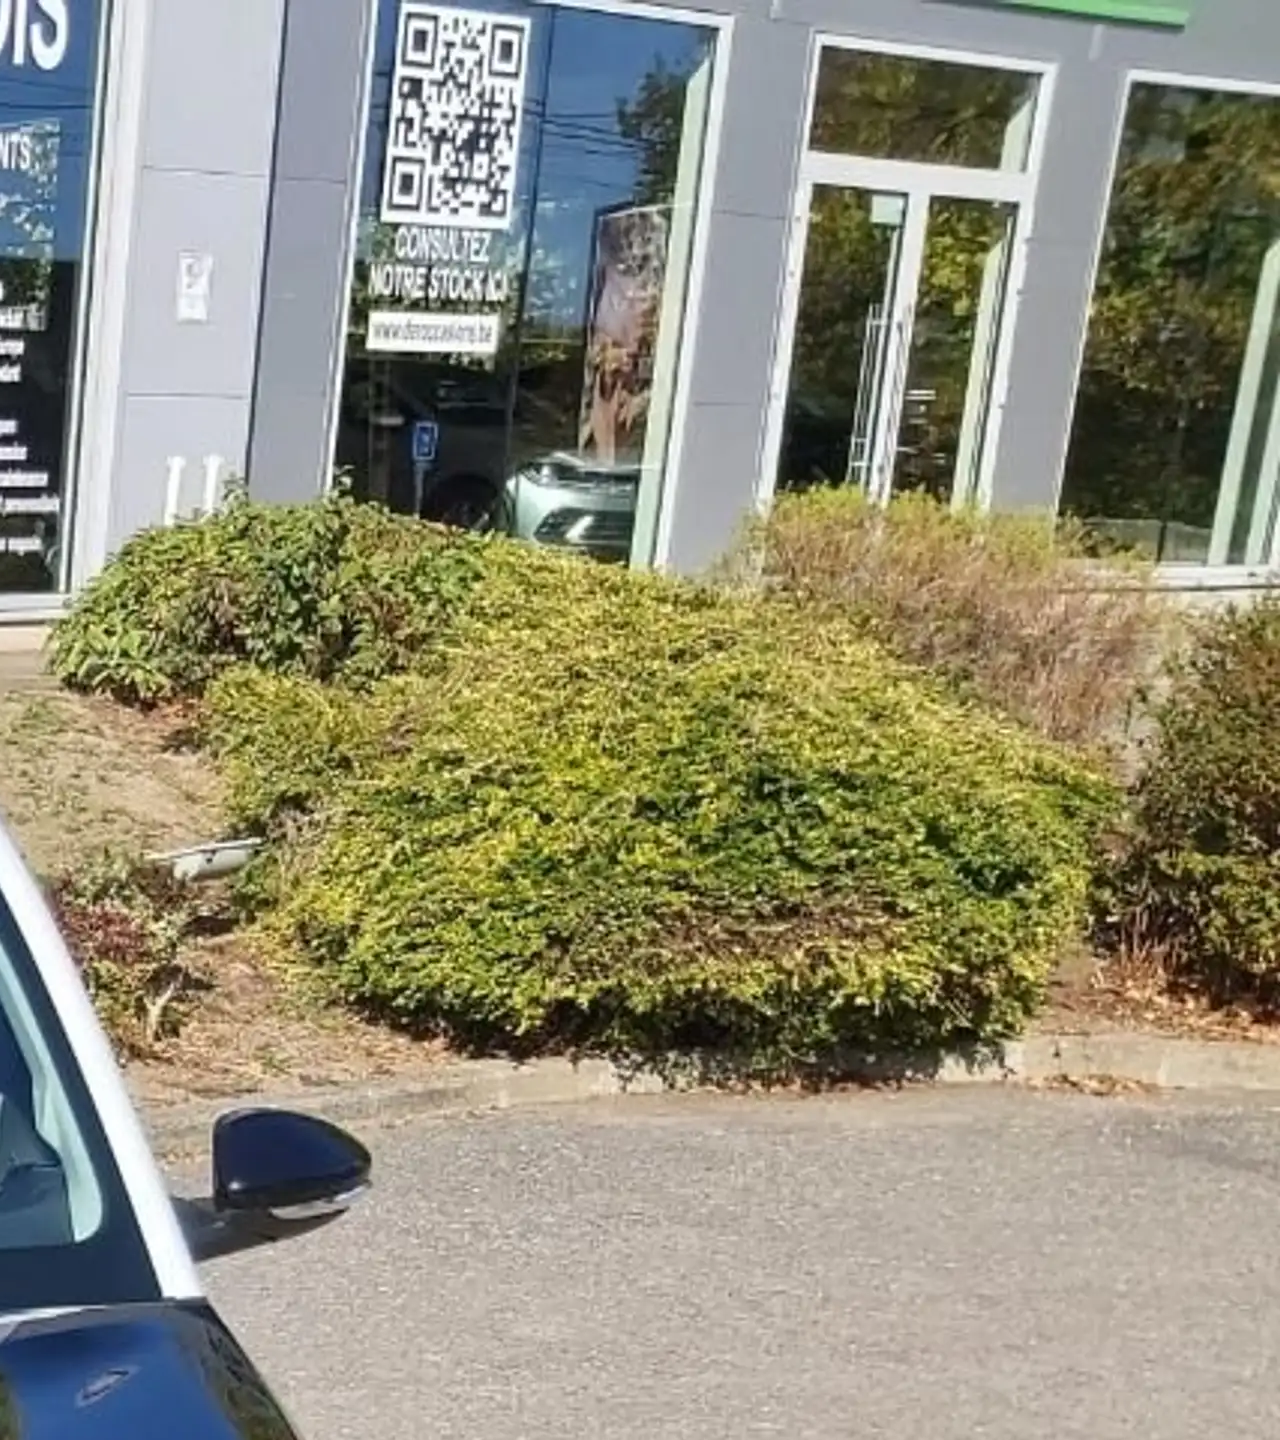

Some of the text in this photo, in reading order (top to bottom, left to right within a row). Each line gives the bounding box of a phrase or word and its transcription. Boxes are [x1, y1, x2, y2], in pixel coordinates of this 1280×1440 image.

[395, 226, 492, 262] CONSULTEZ
[369, 264, 426, 299] NOTRE
[428, 267, 484, 301] STOCK
